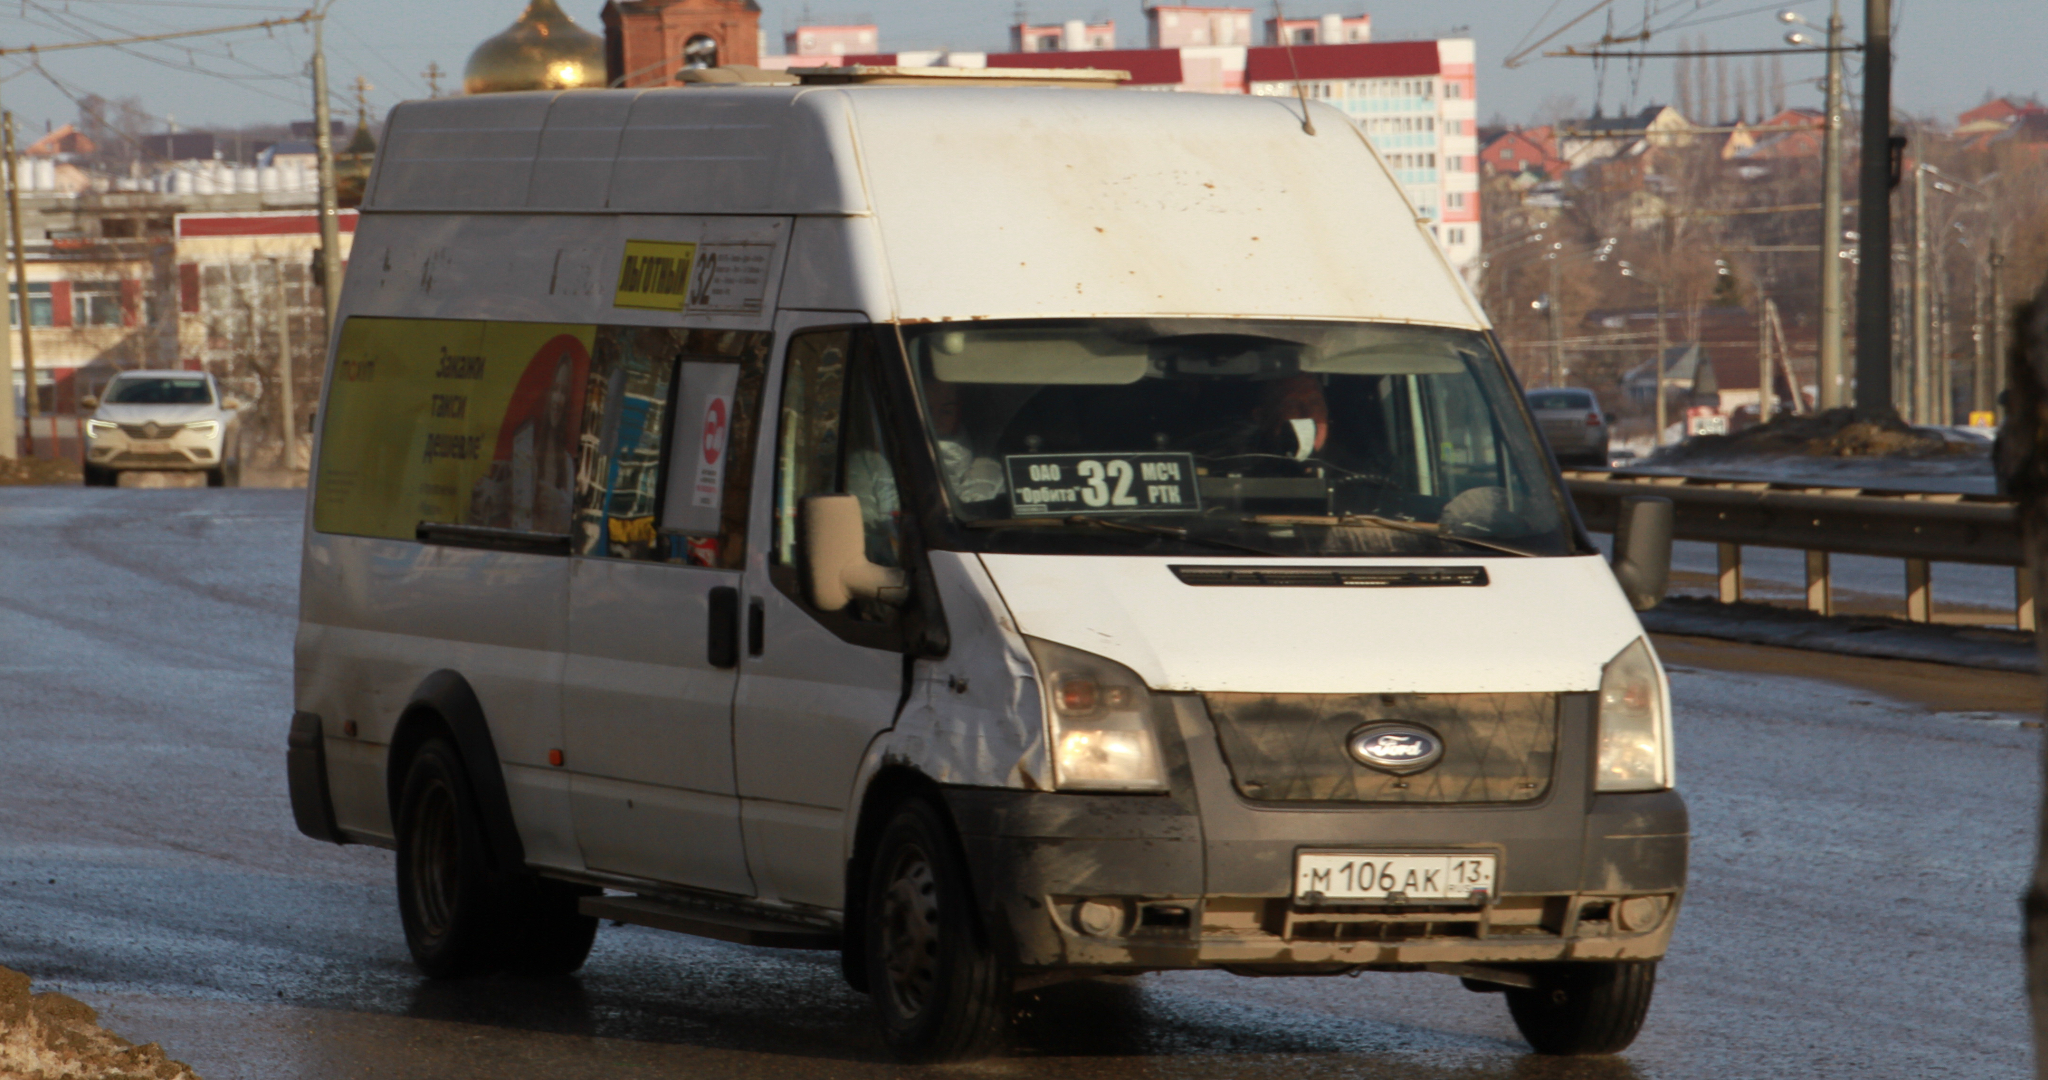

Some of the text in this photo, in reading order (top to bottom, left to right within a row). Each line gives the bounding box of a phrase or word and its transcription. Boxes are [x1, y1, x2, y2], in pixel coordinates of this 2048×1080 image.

[618, 251, 691, 295] ЛЬГОТНЫЙ
[690, 252, 717, 305] 32
[436, 346, 486, 380] Закажи
[431, 394, 467, 419] такси
[1029, 464, 1061, 481] ОАО
[1077, 459, 1138, 508] 32
[1140, 462, 1182, 481] МСЧ
[1147, 485, 1182, 504] РТК
[1366, 735, 1423, 756] Ford
